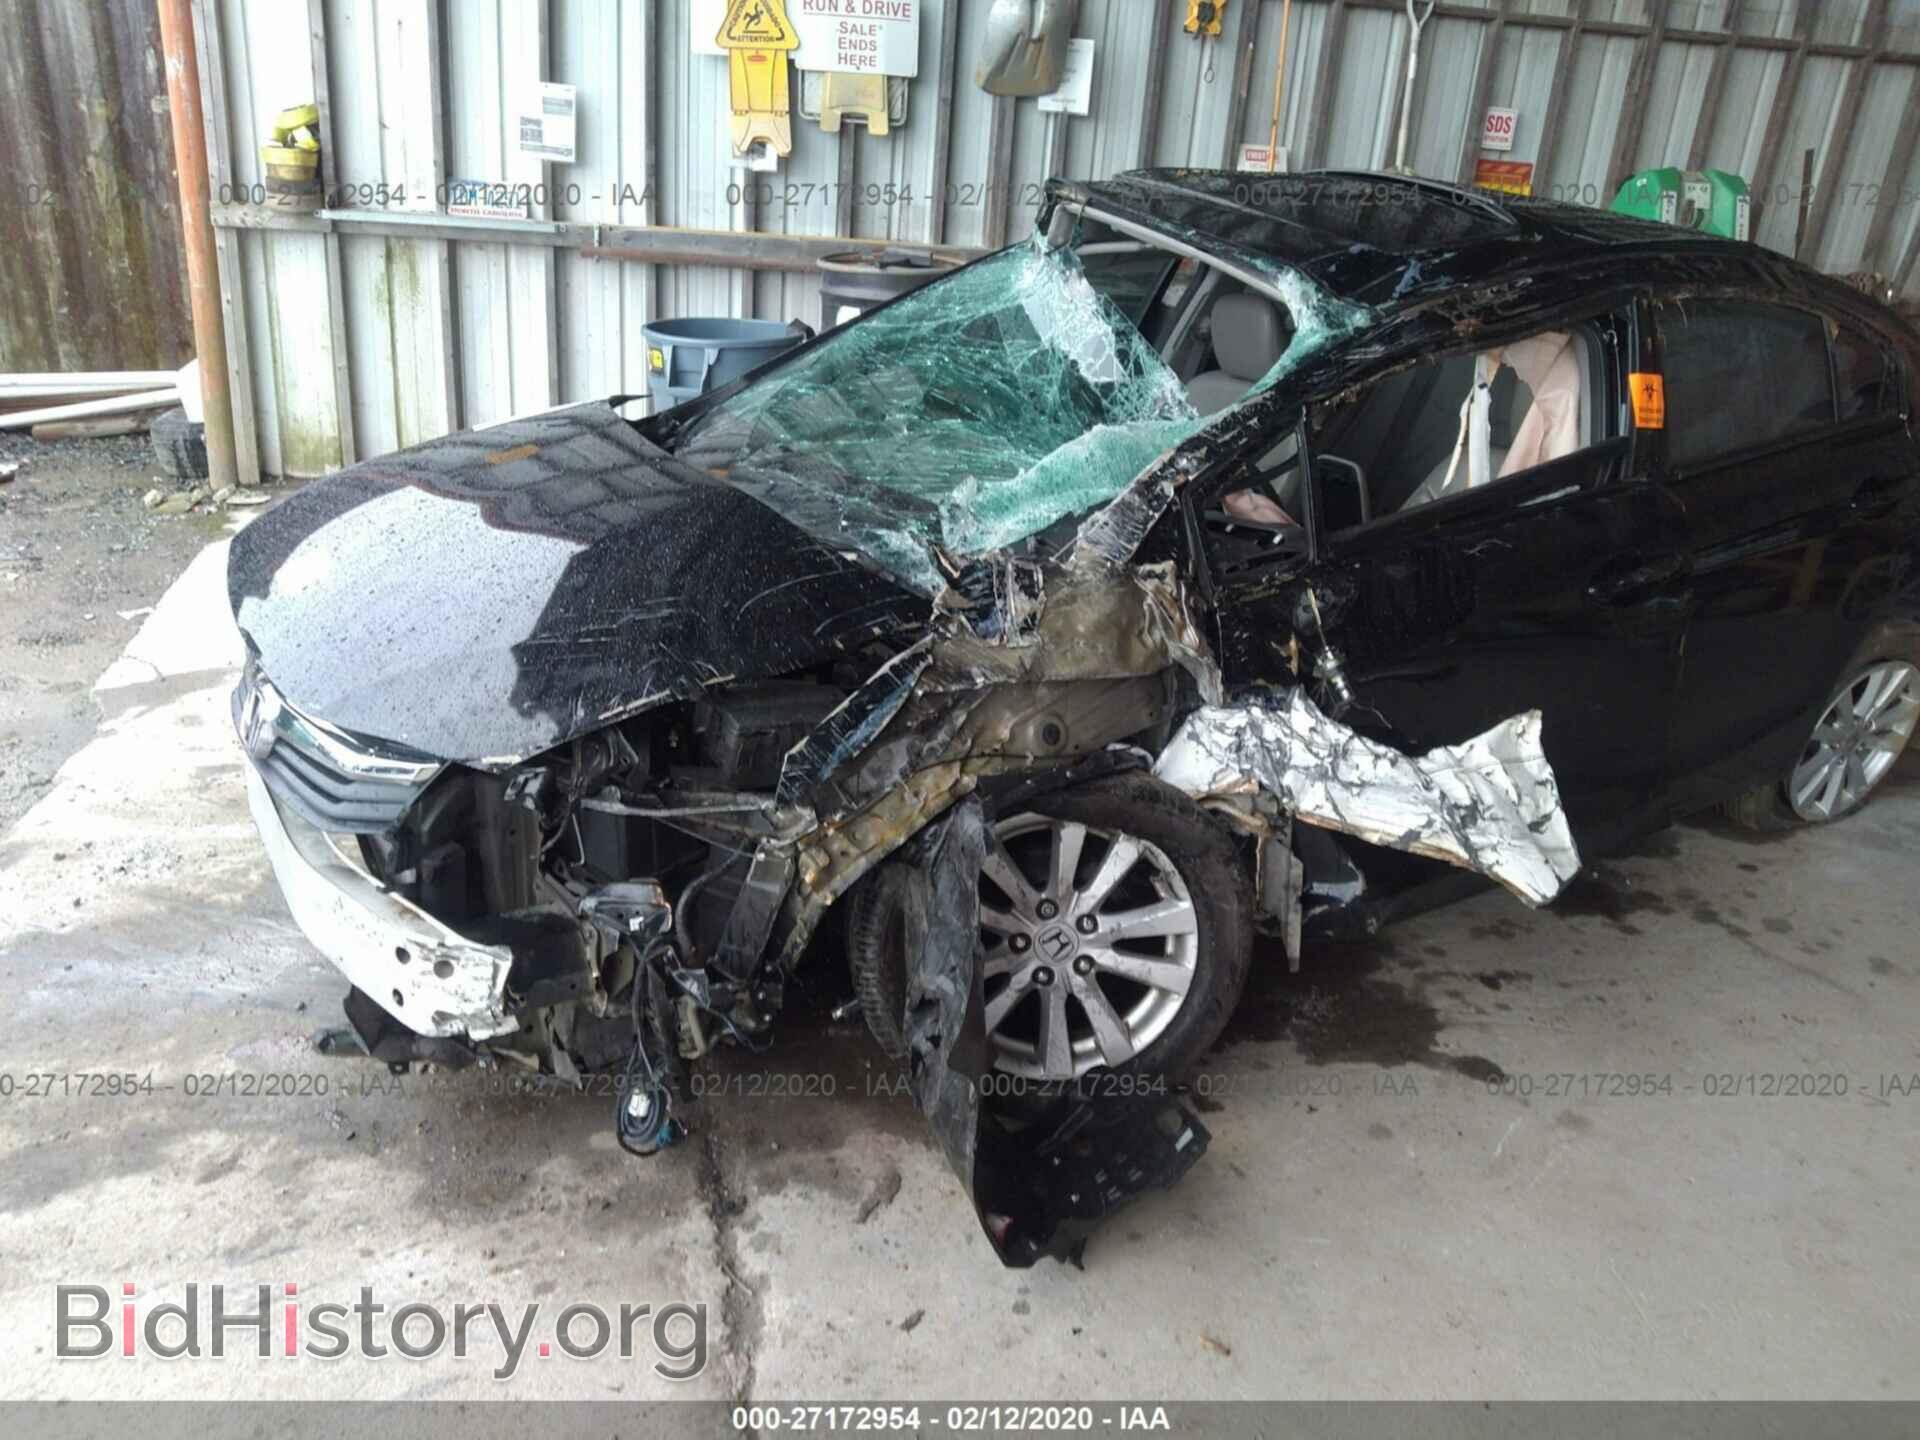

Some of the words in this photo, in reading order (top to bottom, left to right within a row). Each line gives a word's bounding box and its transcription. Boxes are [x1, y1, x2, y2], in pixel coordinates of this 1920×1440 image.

[803, 0, 838, 12] RUN
[845, 0, 856, 13] &
[862, 0, 912, 18] DRIVE
[839, 21, 877, 36] SALE
[838, 37, 877, 51] ENDS
[838, 53, 877, 67] HERE
[1487, 115, 1512, 134] SDS
